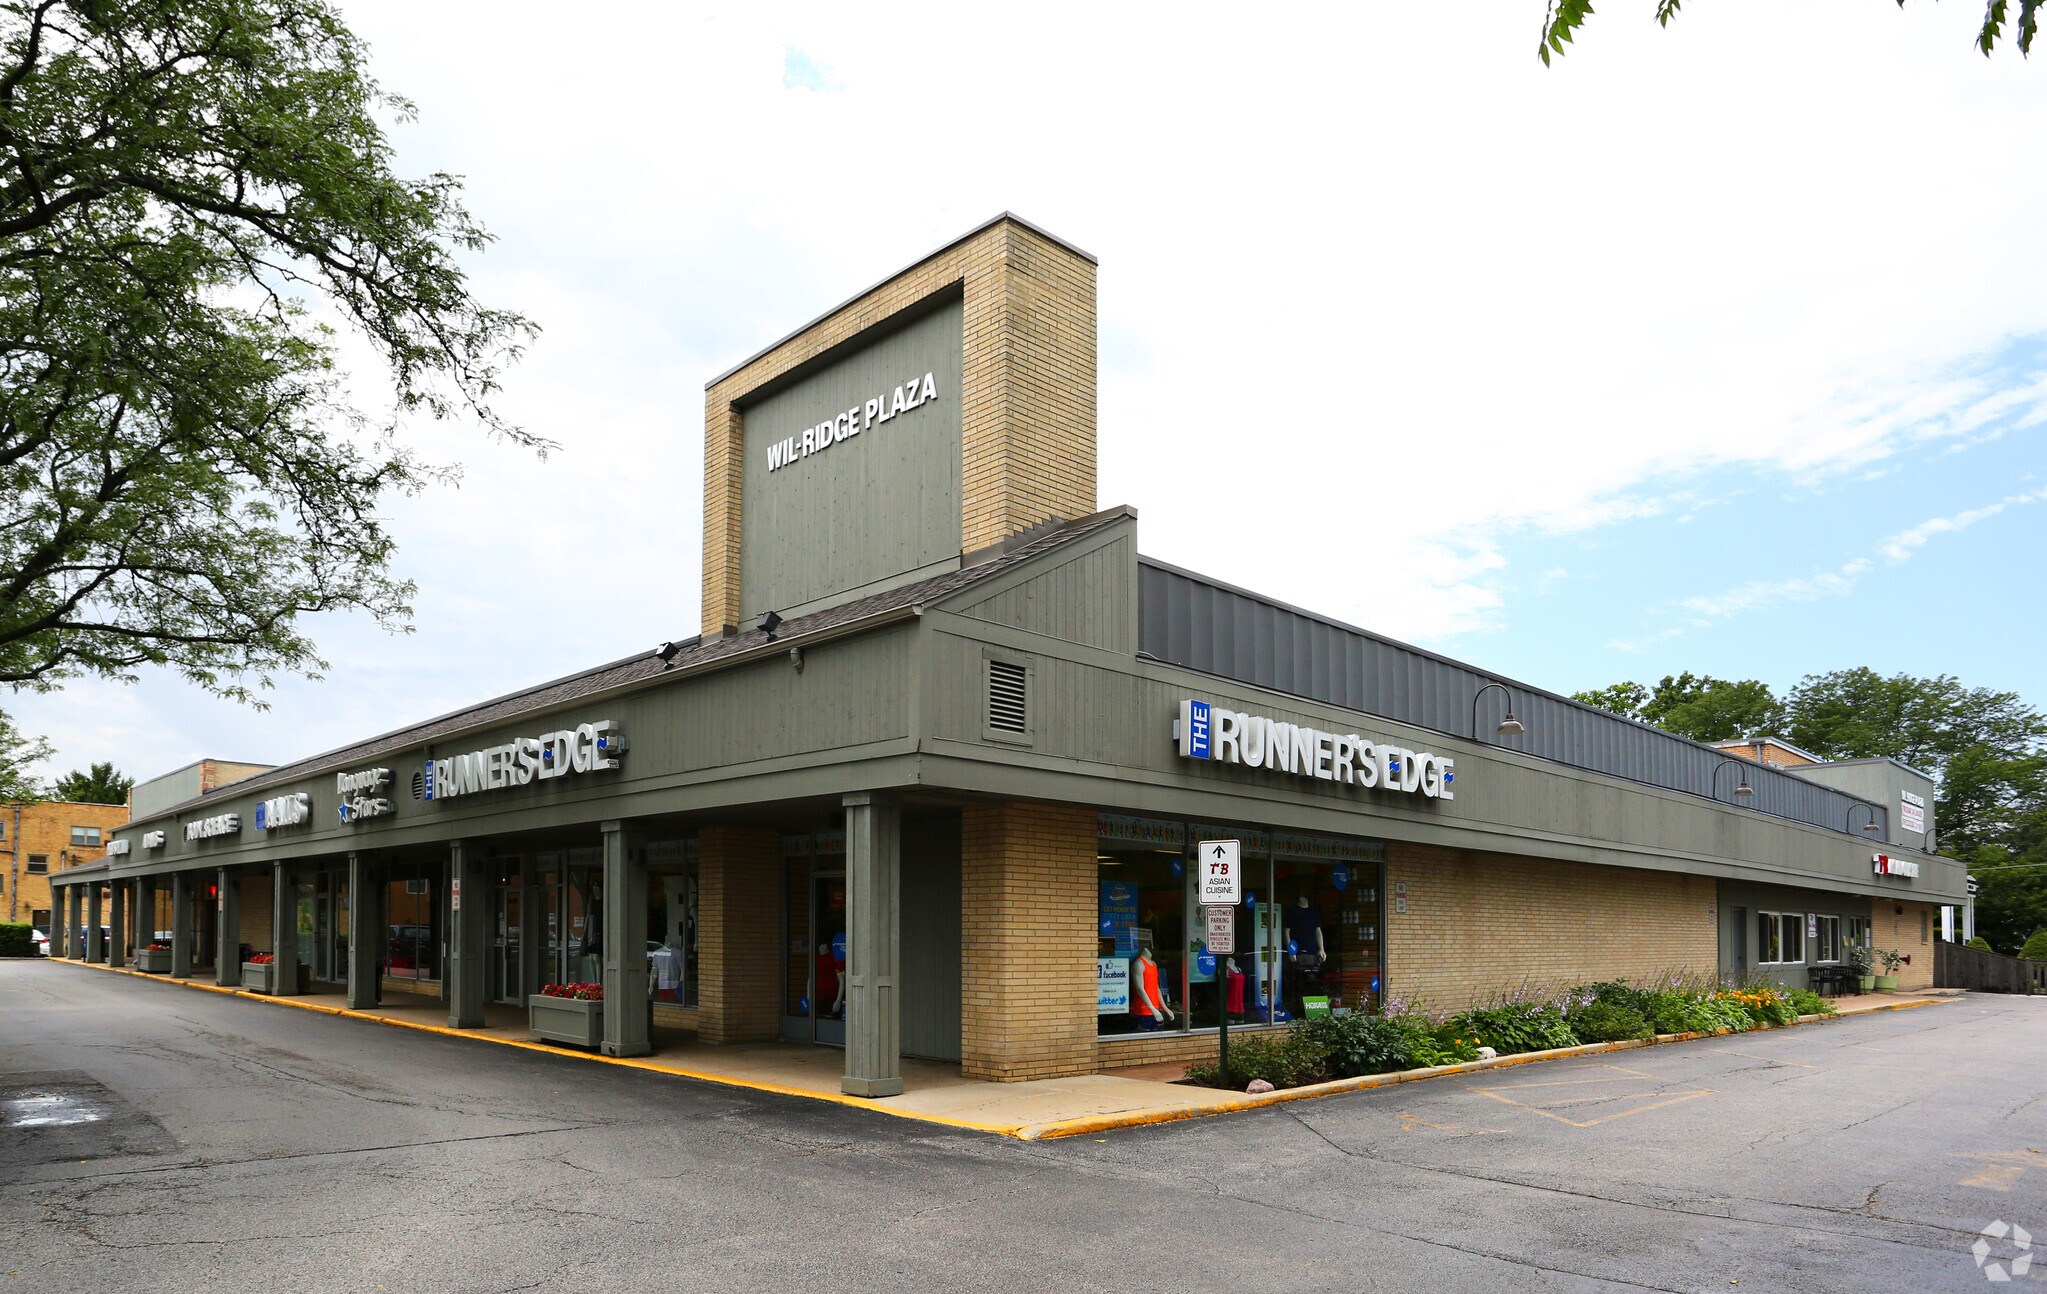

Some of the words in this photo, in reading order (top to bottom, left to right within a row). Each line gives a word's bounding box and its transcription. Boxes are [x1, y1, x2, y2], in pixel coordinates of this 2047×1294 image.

[767, 406, 860, 472] WIL-RIDGE
[865, 371, 938, 430] PLAZA
[425, 764, 433, 798] THE
[435, 737, 538, 798] RUNNER'S
[539, 719, 616, 779] EDGE
[1193, 706, 1207, 752] THE
[1214, 707, 1379, 789] RUNNER'S
[1380, 745, 1454, 800] EDGE
[351, 796, 387, 819] Stars
[1205, 886, 1233, 894] CUISINE
[1103, 971, 1126, 979] facebook
